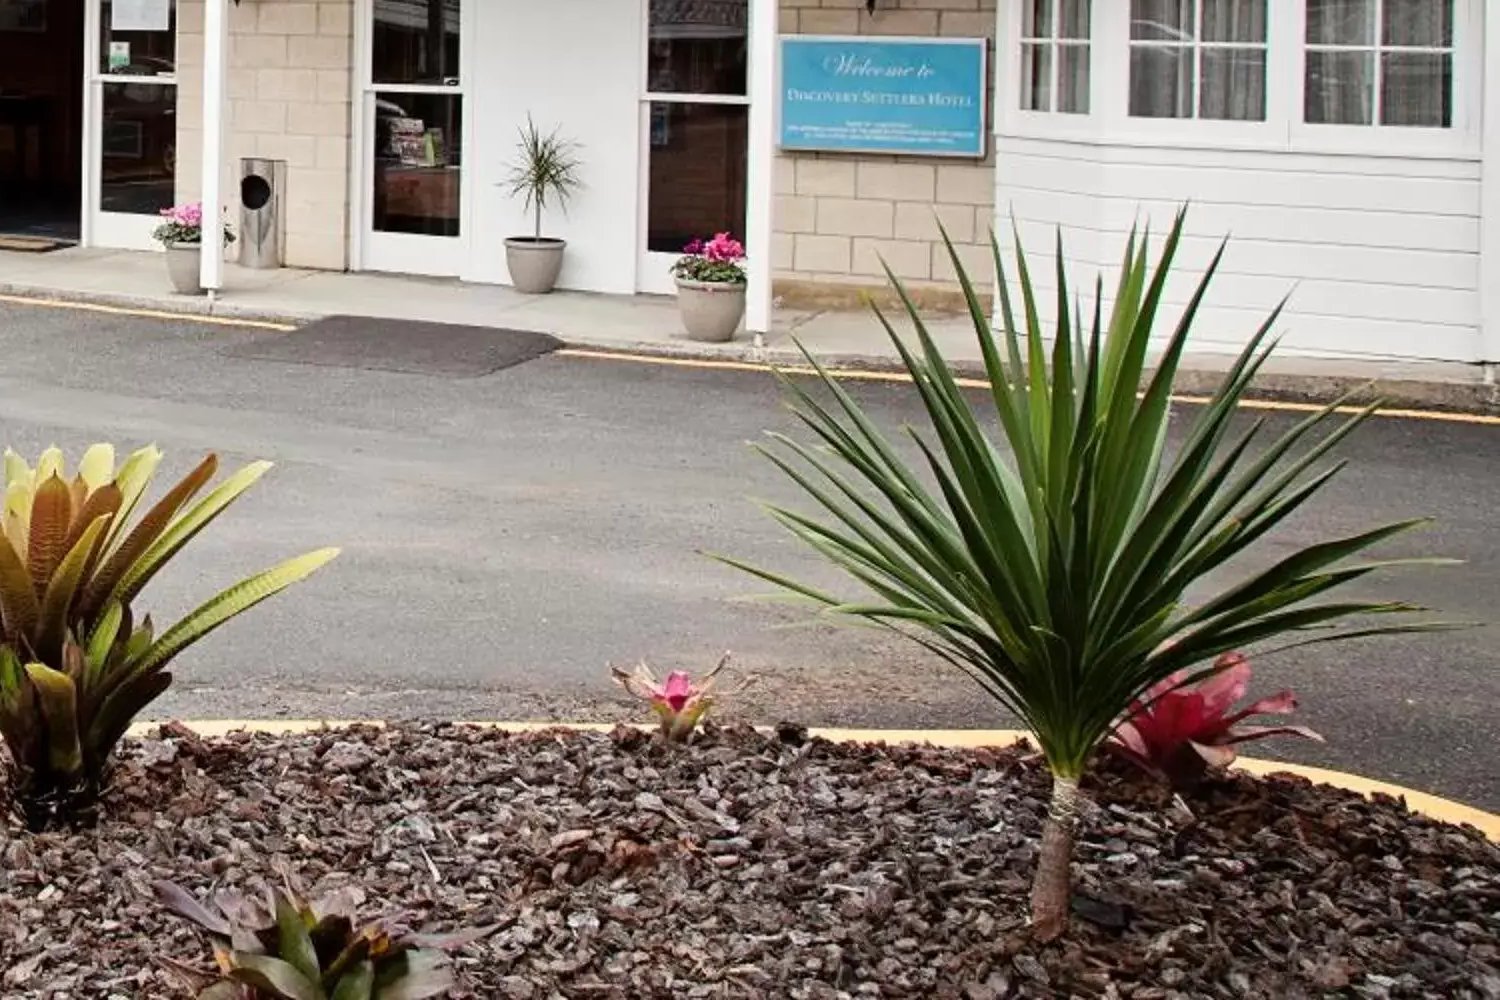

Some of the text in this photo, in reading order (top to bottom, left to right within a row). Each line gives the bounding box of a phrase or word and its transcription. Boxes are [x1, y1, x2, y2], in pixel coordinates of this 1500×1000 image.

[821, 53, 935, 78] Welcome to
[928, 92, 973, 108] HOTEL
